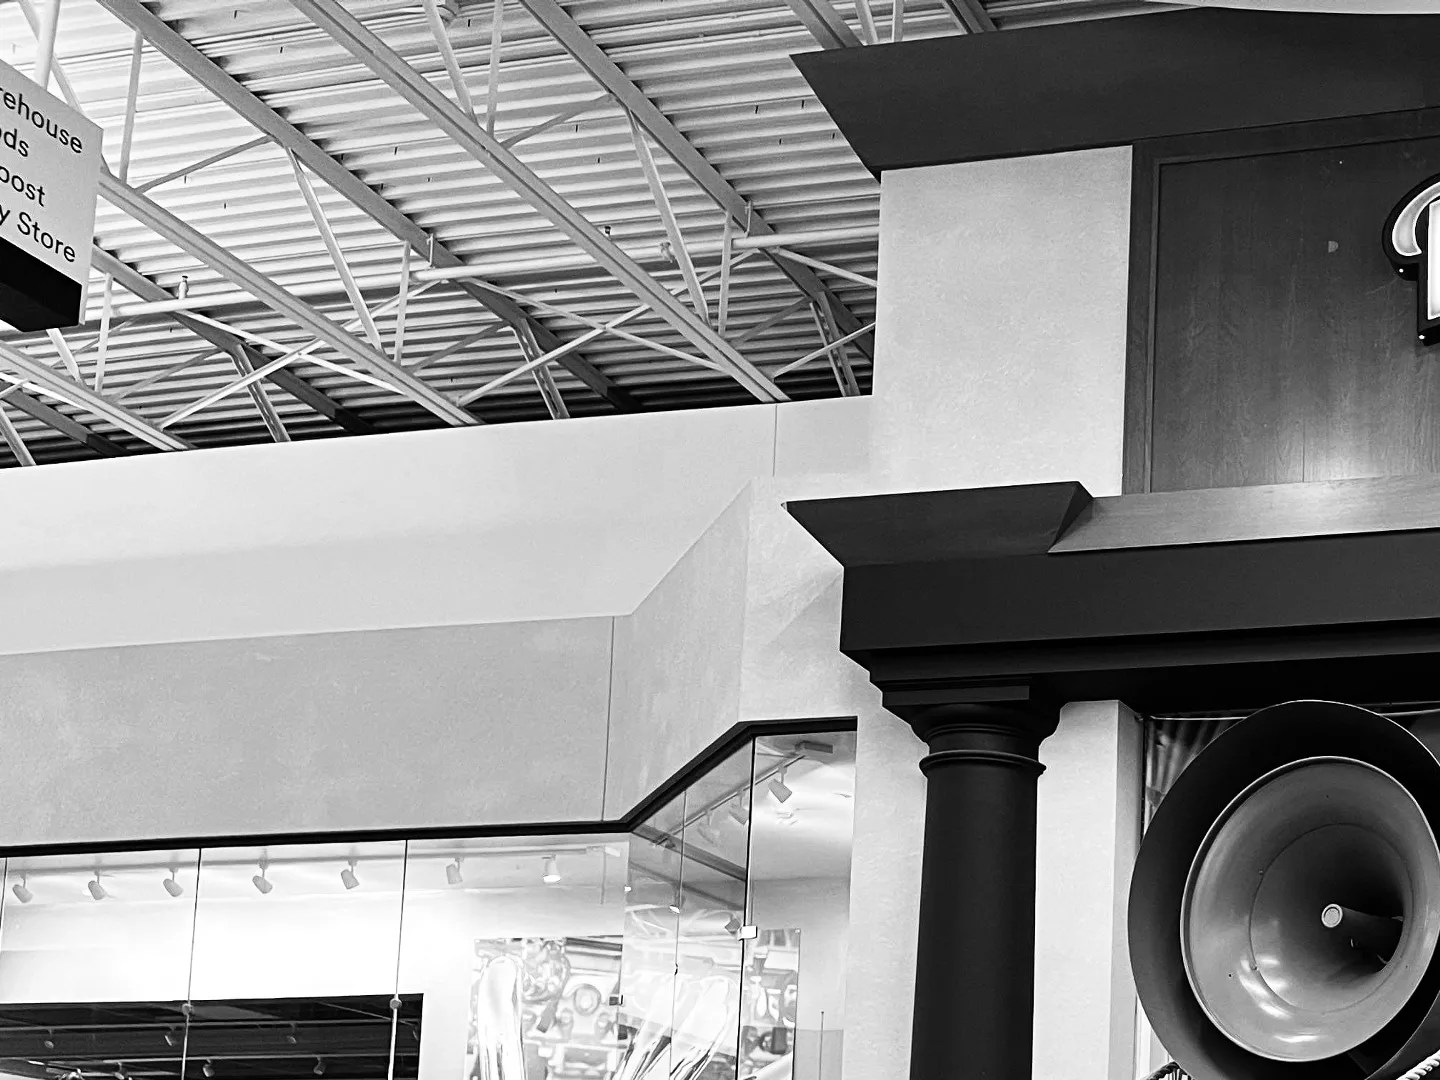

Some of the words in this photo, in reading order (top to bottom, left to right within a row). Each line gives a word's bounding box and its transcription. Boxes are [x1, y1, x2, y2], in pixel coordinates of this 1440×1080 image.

[0, 87, 83, 154] ehouse
[0, 128, 29, 157] ds
[17, 211, 76, 263] Store
